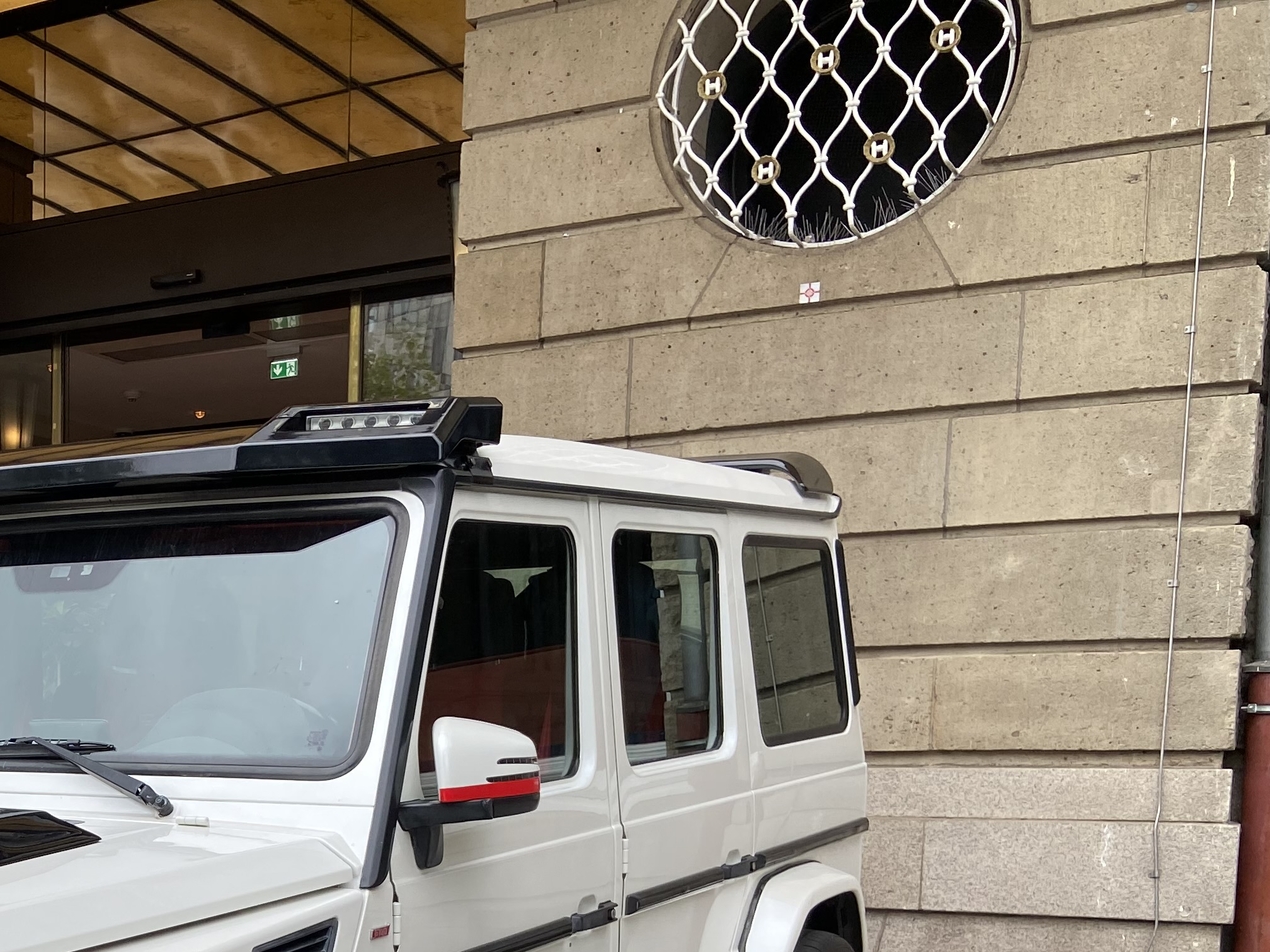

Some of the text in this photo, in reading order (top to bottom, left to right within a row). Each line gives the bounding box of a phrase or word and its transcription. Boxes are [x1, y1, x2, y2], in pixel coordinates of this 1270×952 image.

[938, 27, 956, 45] H
[818, 50, 835, 69] H
[705, 77, 721, 95] H
[871, 139, 889, 157] H
[760, 162, 774, 180] H
